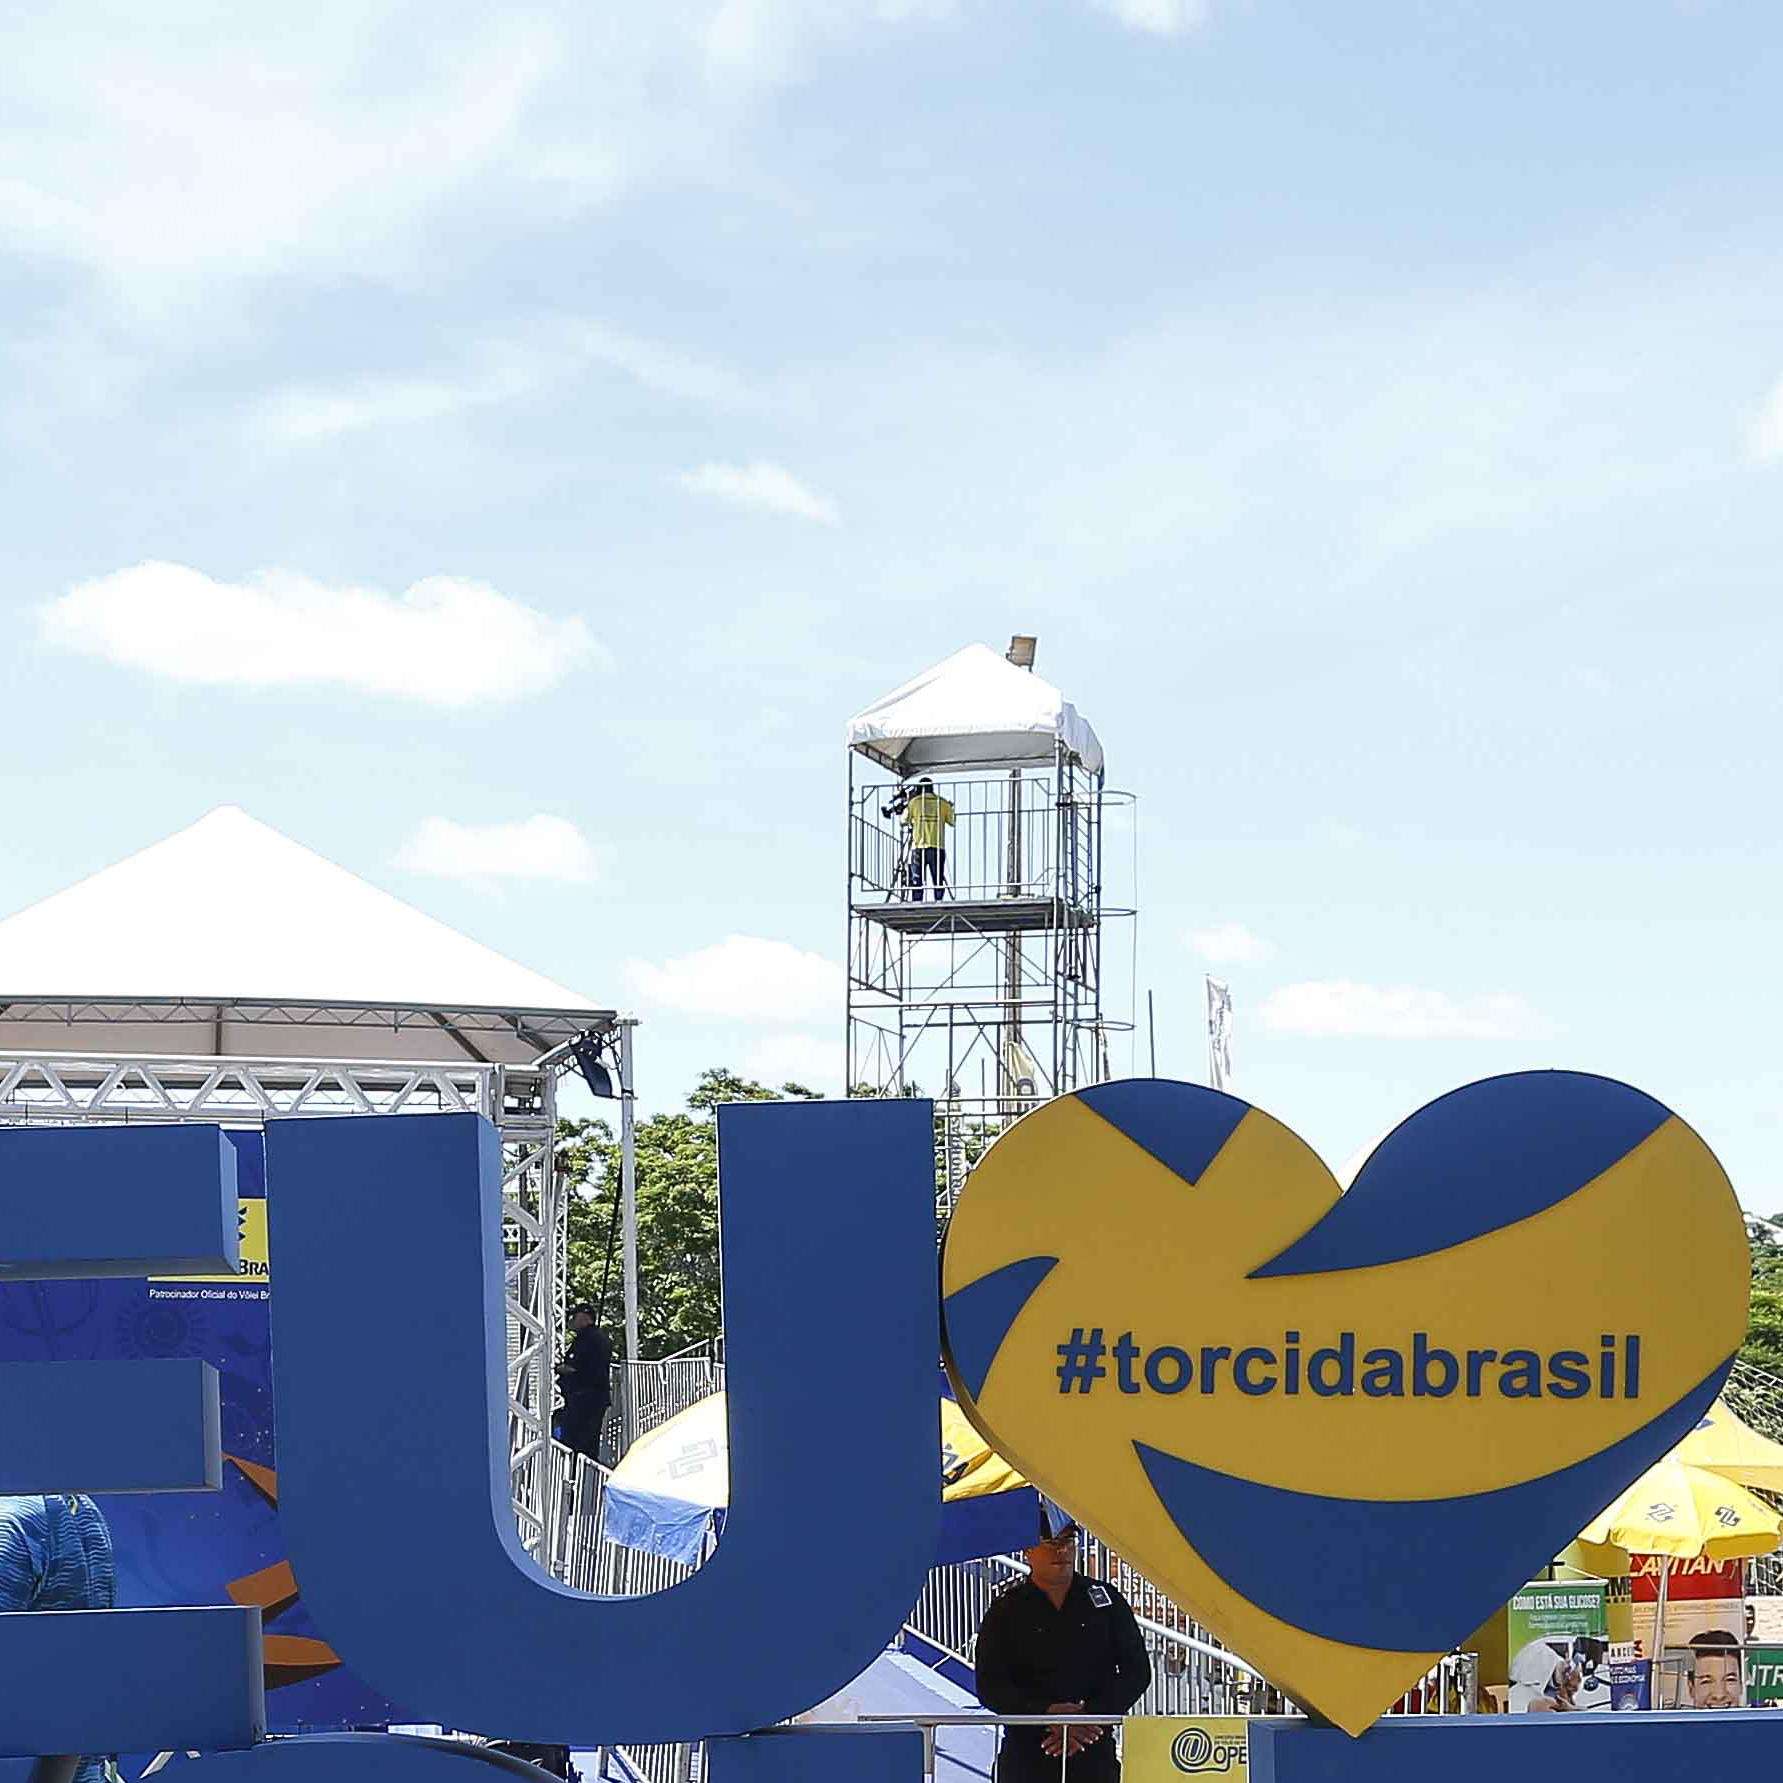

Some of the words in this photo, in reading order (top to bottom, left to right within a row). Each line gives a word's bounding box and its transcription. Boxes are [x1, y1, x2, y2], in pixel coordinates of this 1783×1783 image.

[149, 1288, 199, 1299] Patrocinador
[200, 1289, 226, 1300] Oficial
[1055, 1326, 1641, 1401] #torcidabrasil
[1512, 1595, 1534, 1610] COMO
[1554, 1595, 1568, 1609] SUA
